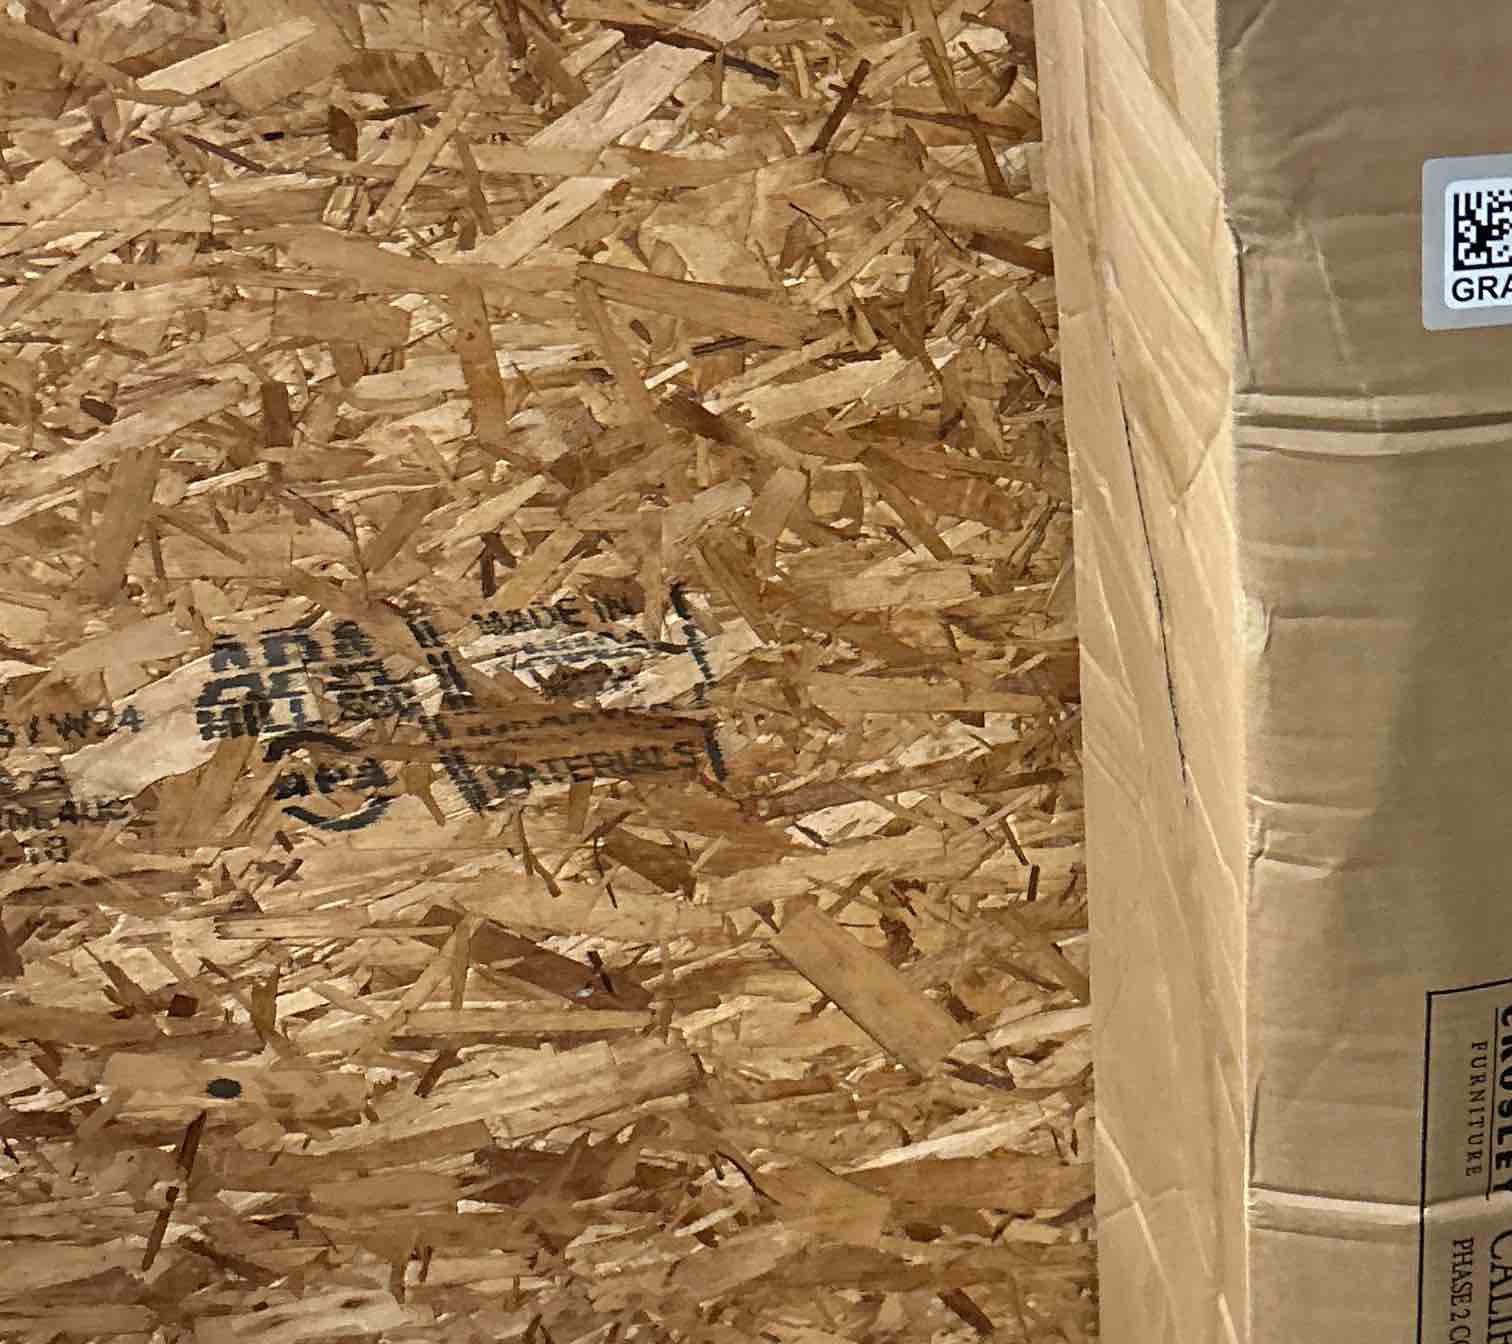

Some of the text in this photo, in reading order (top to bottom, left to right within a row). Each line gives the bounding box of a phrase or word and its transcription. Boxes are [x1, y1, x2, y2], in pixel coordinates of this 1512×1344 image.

[1465, 1041, 1488, 1177] FURNITURE
[1451, 1237, 1474, 1306] PHASE
[1450, 1309, 1471, 1322] 2
